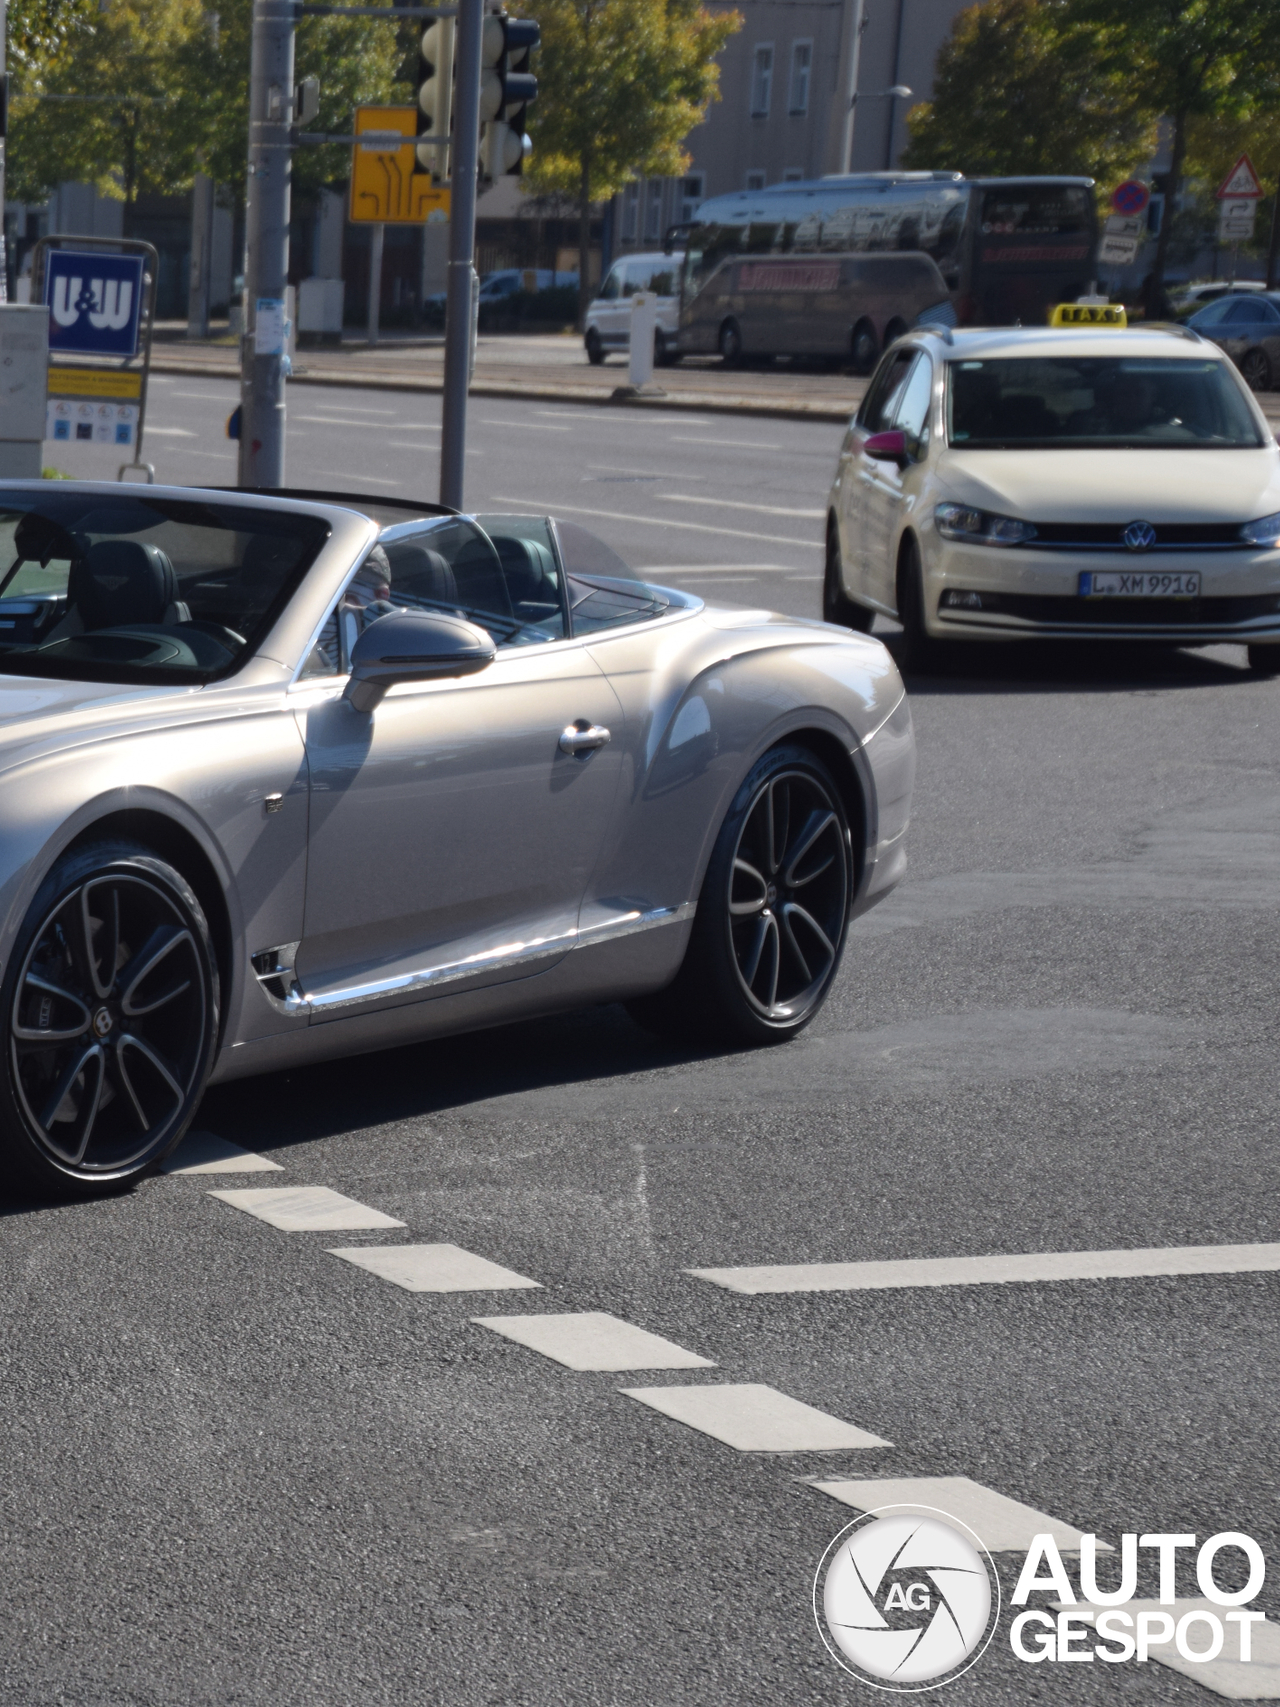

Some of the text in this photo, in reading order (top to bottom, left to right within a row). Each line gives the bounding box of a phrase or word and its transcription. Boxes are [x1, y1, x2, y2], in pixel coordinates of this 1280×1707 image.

[53, 275, 133, 330] U&W
[1066, 307, 1118, 321] TAXI
[1093, 575, 1105, 593] L
[1119, 575, 1144, 593] XM
[1149, 575, 1197, 594] 9916
